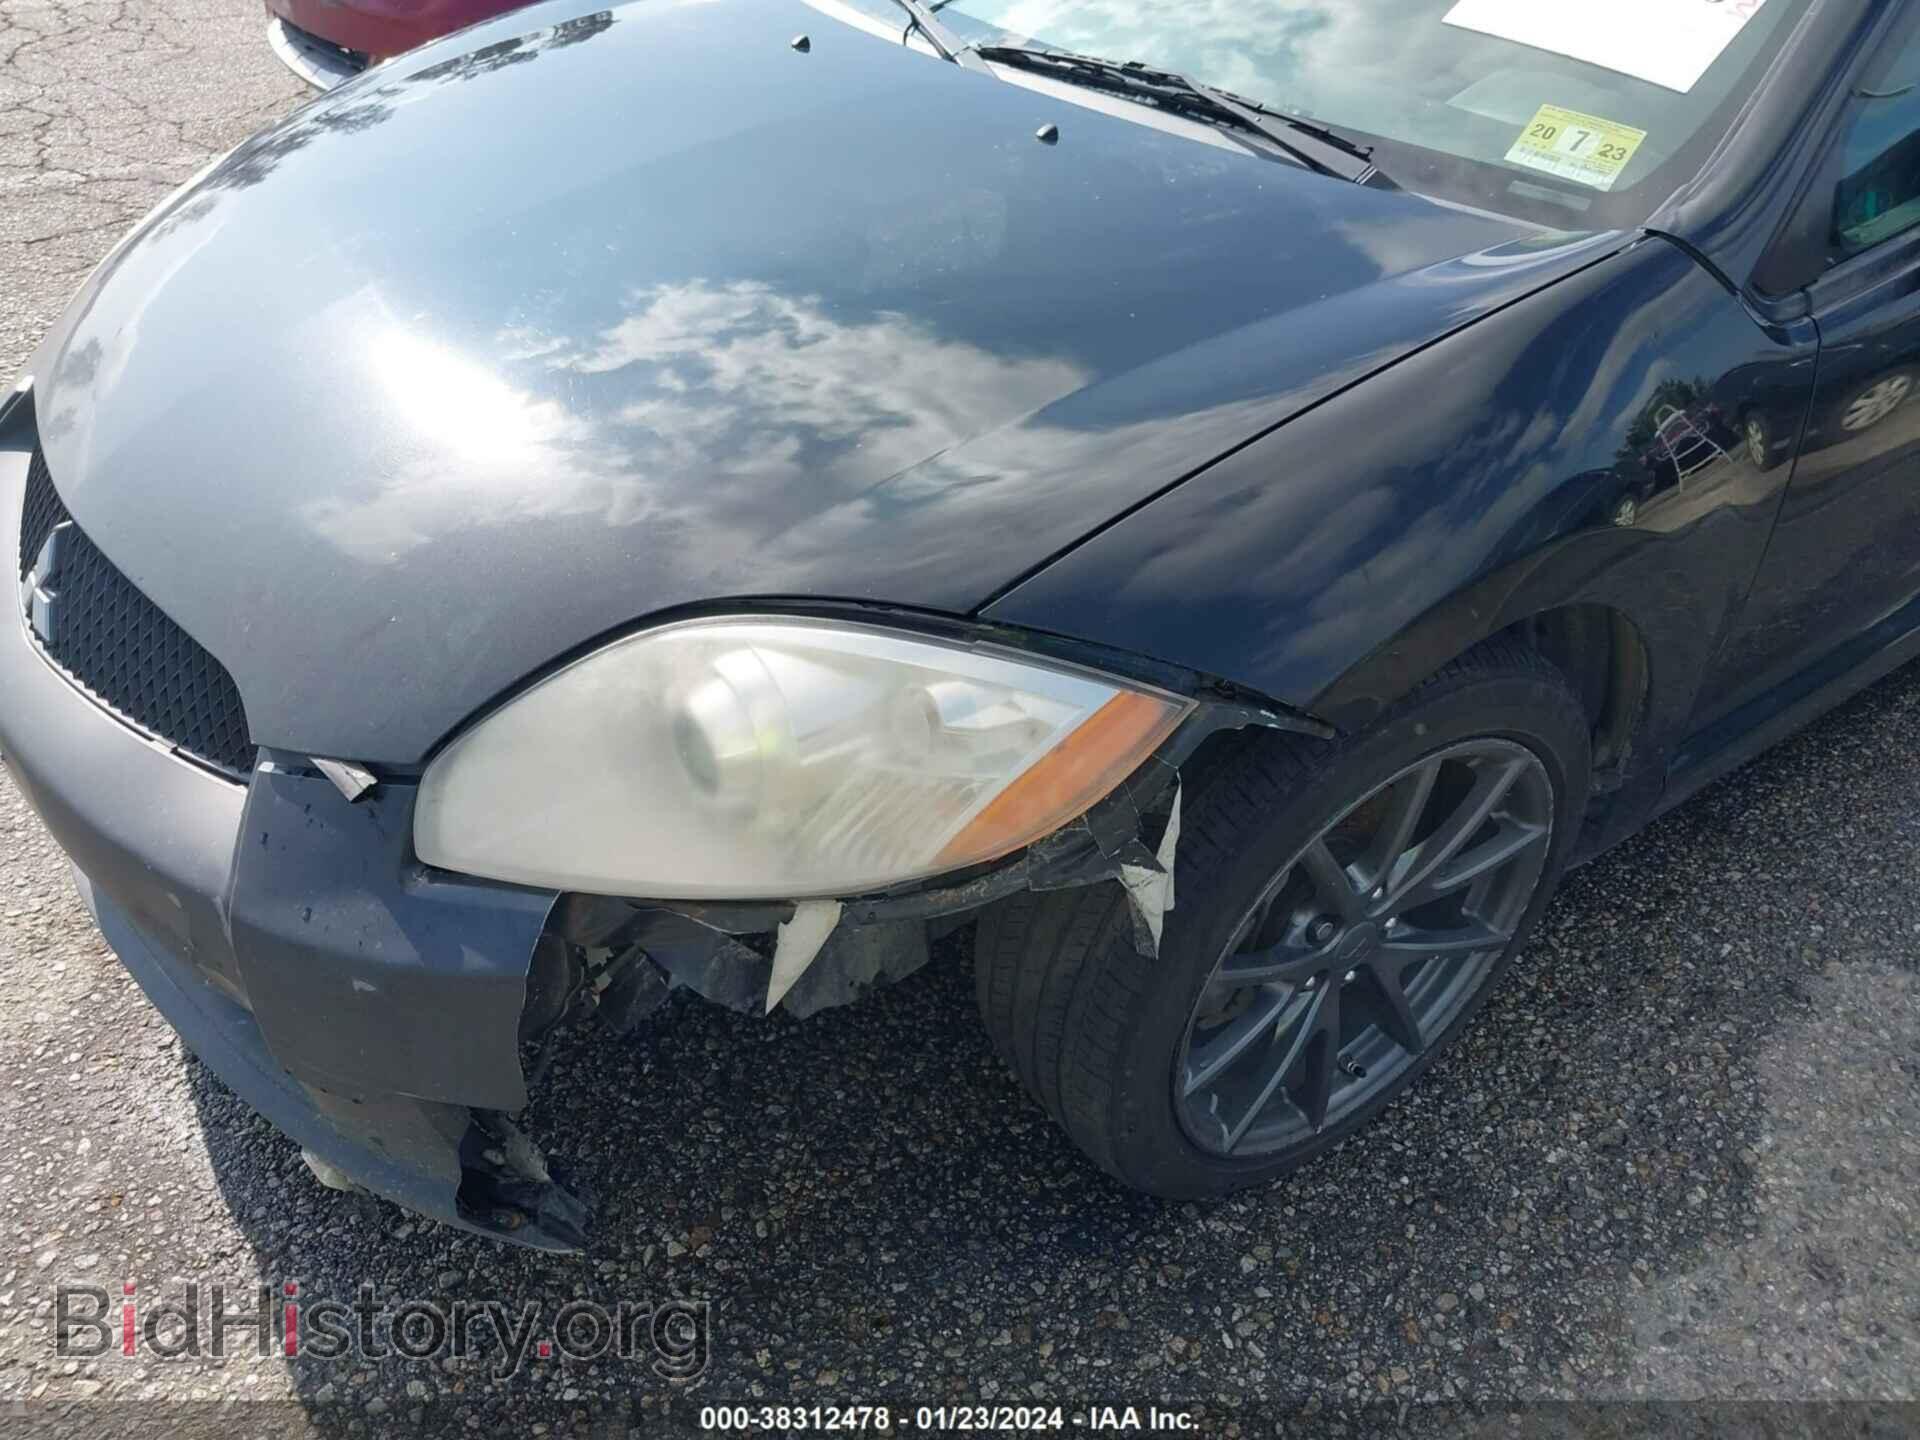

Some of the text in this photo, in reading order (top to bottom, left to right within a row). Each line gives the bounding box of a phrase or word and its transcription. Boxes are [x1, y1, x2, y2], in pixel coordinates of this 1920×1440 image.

[1530, 123, 1556, 140] 20
[1568, 130, 1591, 152] 7
[1598, 143, 1627, 161] 23
